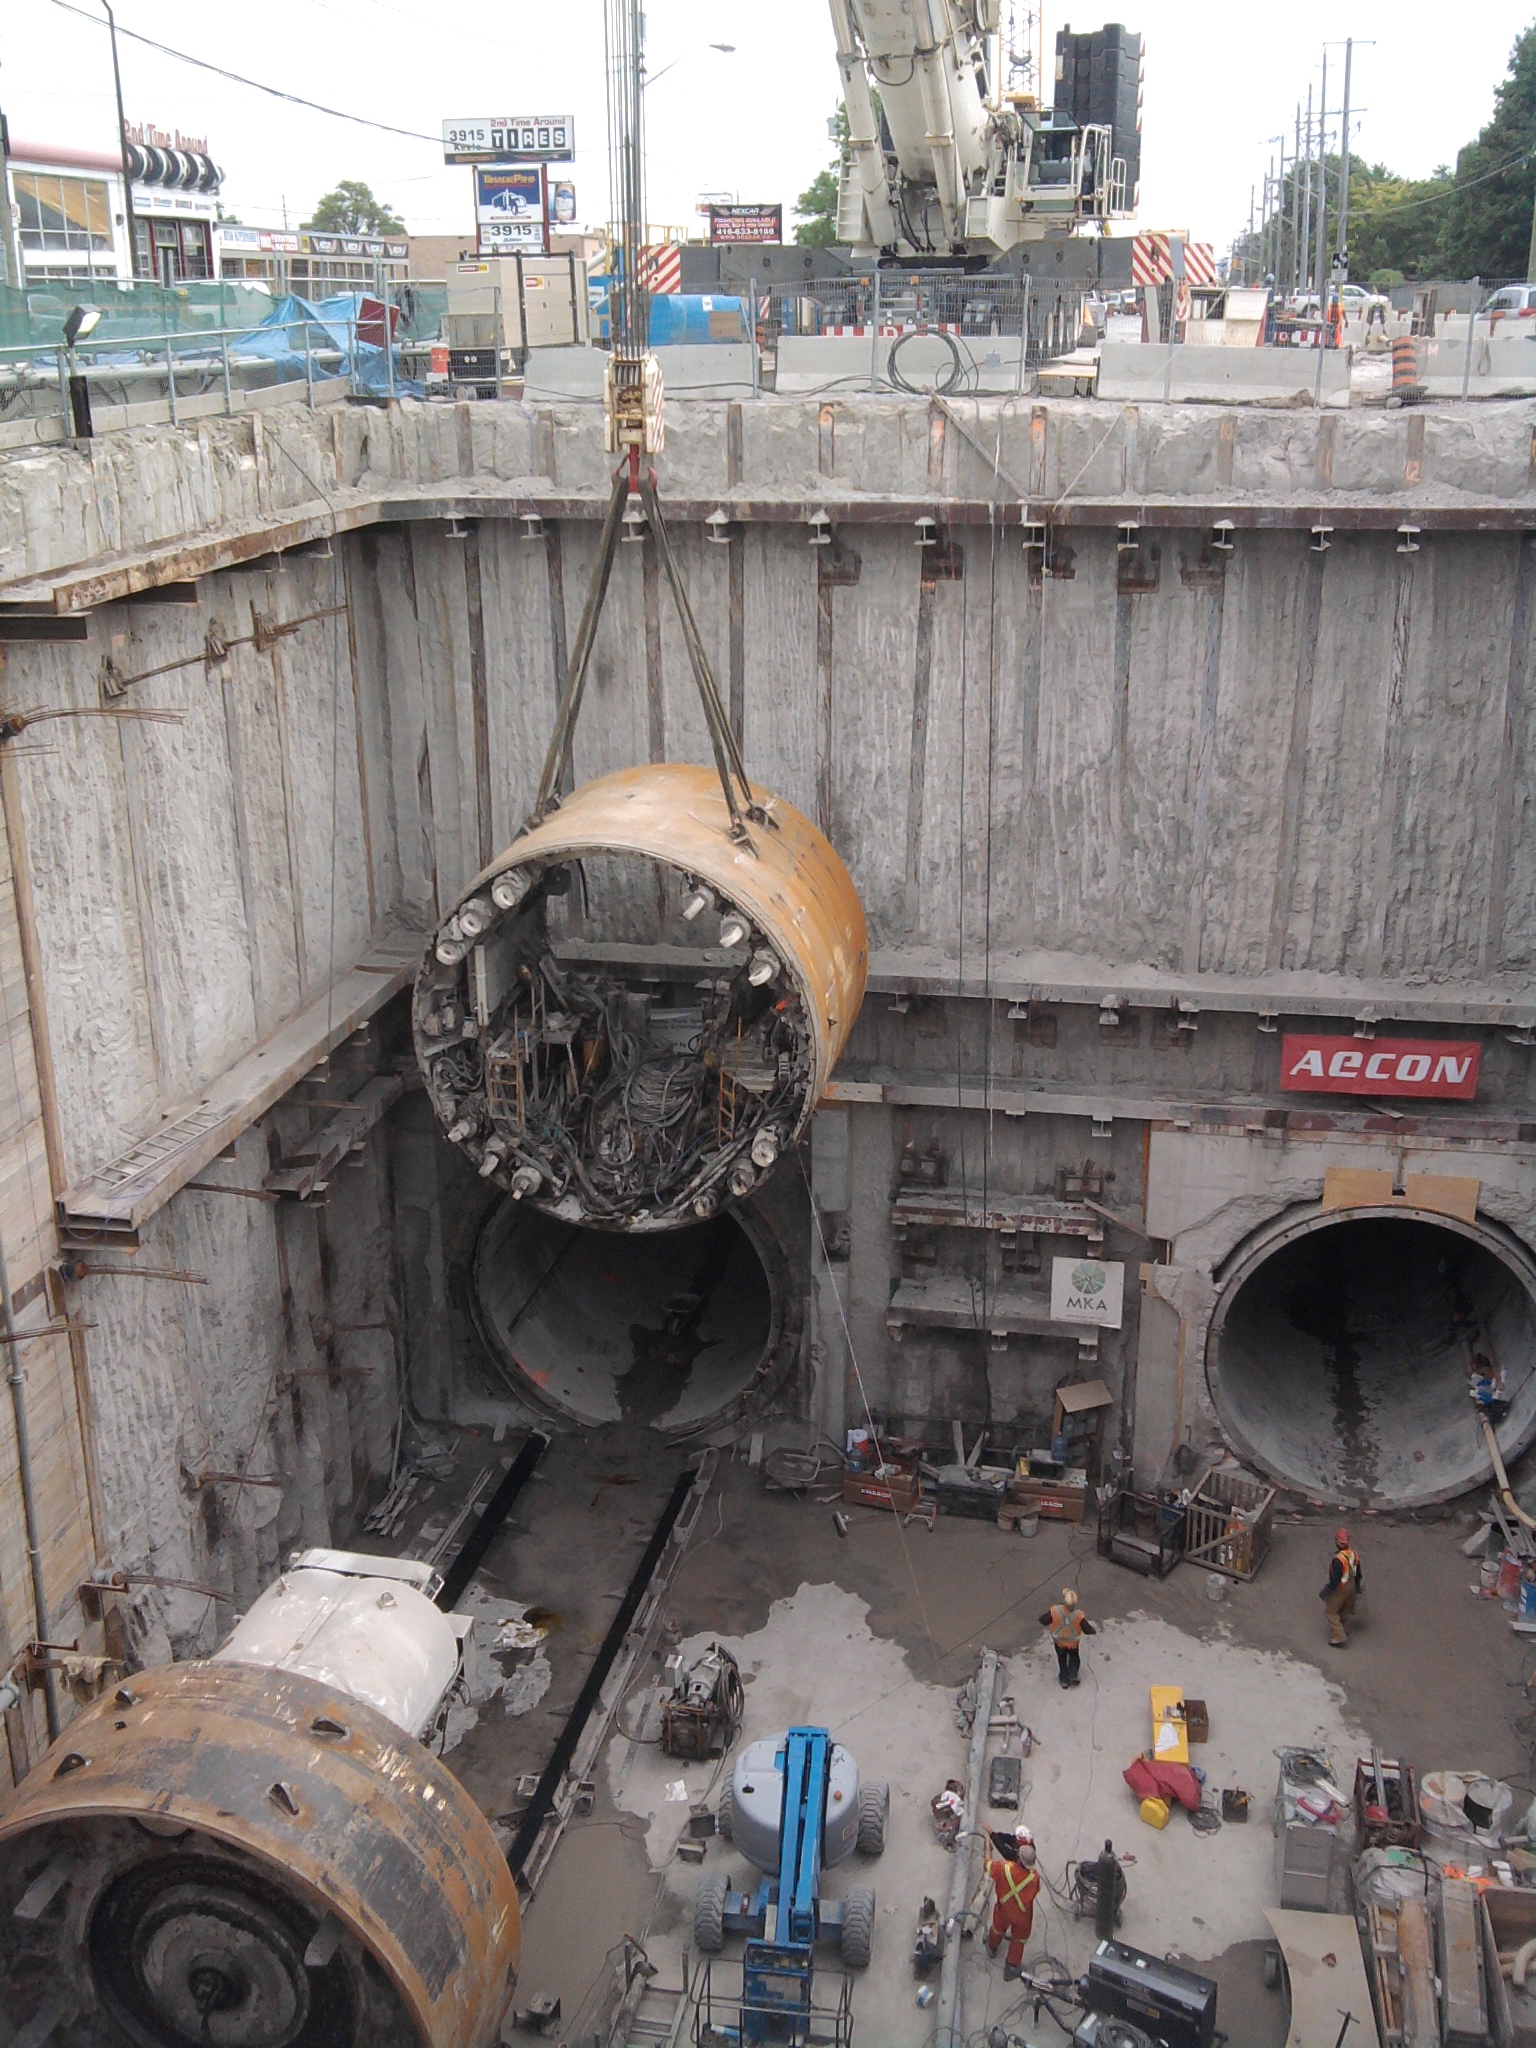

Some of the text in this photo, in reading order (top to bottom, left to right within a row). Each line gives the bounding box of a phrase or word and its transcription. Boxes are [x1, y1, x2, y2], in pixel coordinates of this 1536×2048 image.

[490, 117, 566, 128] 2nd Time Around
[124, 118, 208, 155] 2nd Time Around
[449, 129, 485, 142] 3915
[492, 129, 566, 147] TIRES
[491, 225, 532, 237] 3915
[1066, 1296, 1107, 1312] MKA
